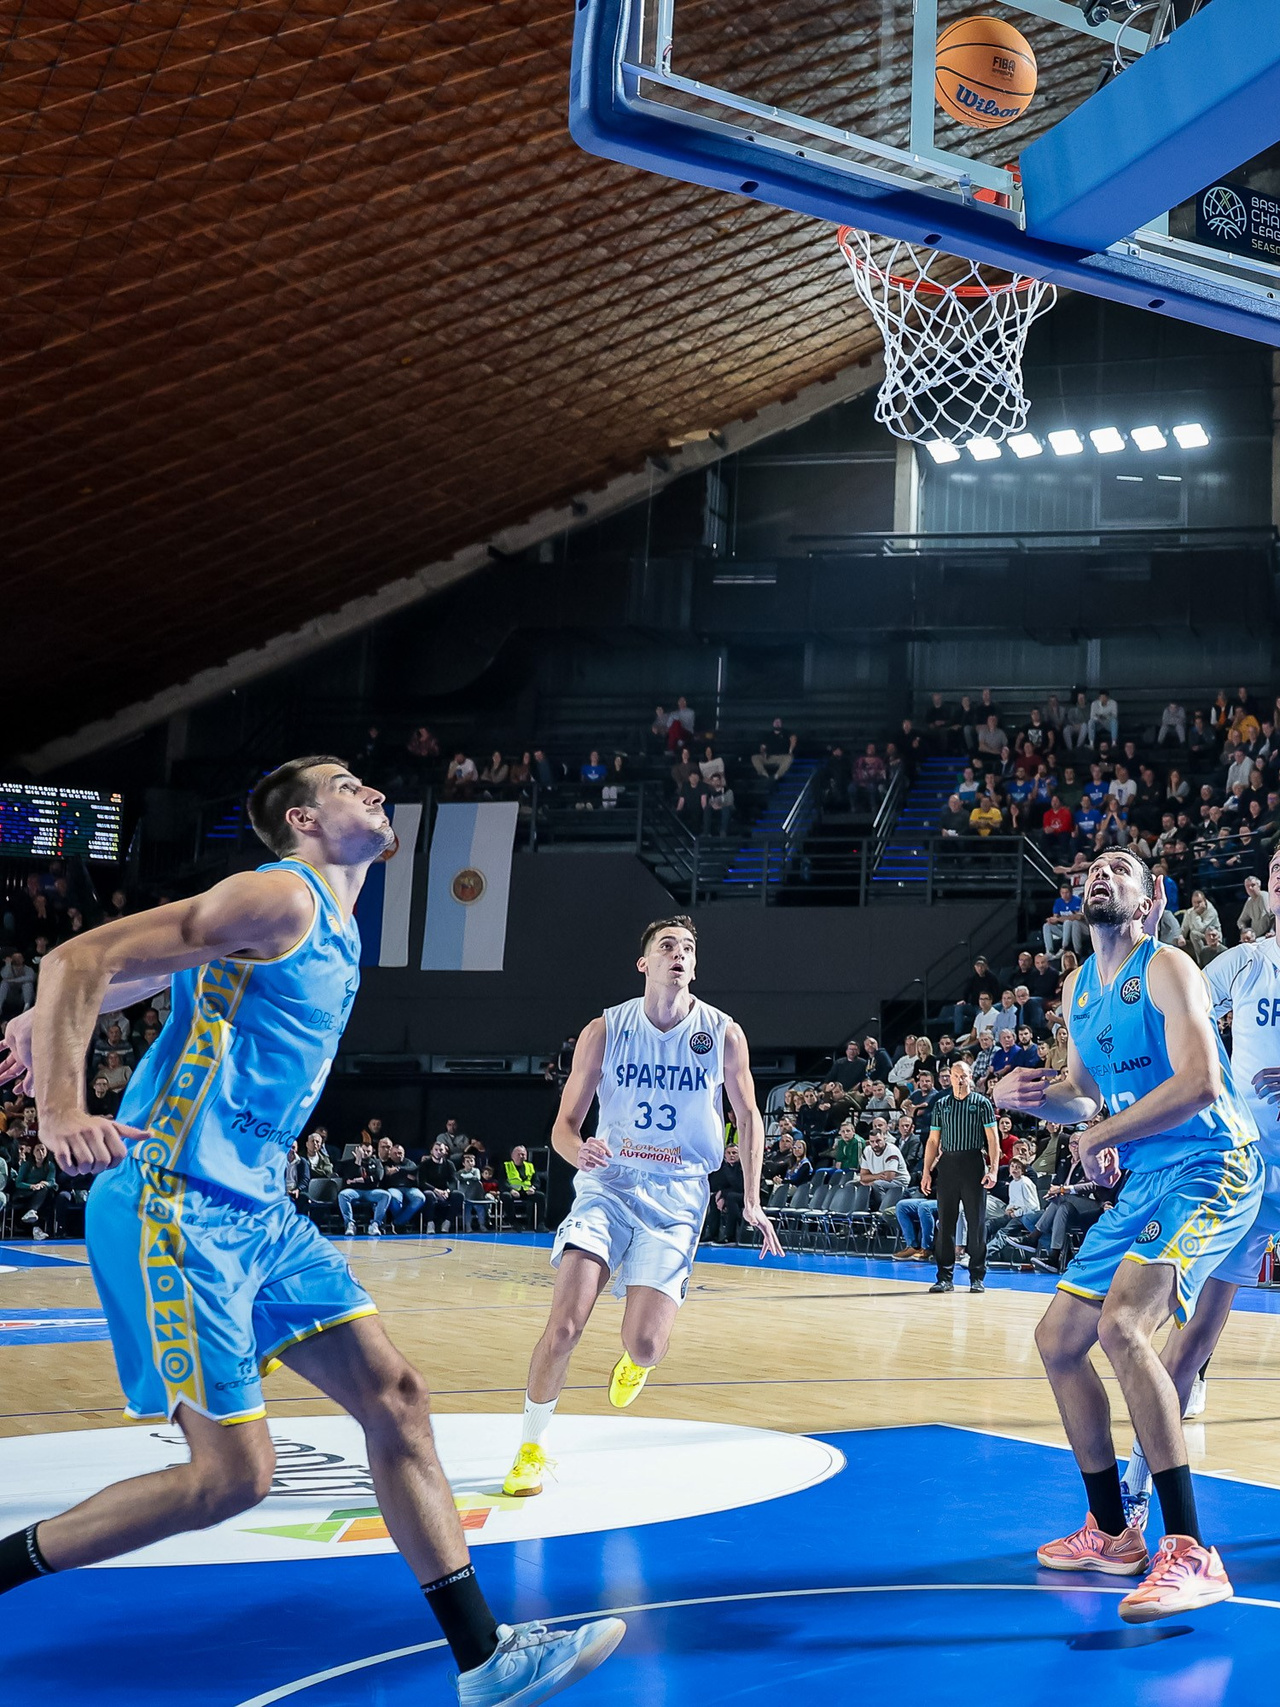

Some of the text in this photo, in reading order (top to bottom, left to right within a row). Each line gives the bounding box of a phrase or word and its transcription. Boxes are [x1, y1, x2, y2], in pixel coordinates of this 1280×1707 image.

[993, 56, 1016, 71] FIBA
[956, 83, 1020, 117] Wilson
[616, 1063, 708, 1091] SPARTAK
[634, 1101, 677, 1131] 33
